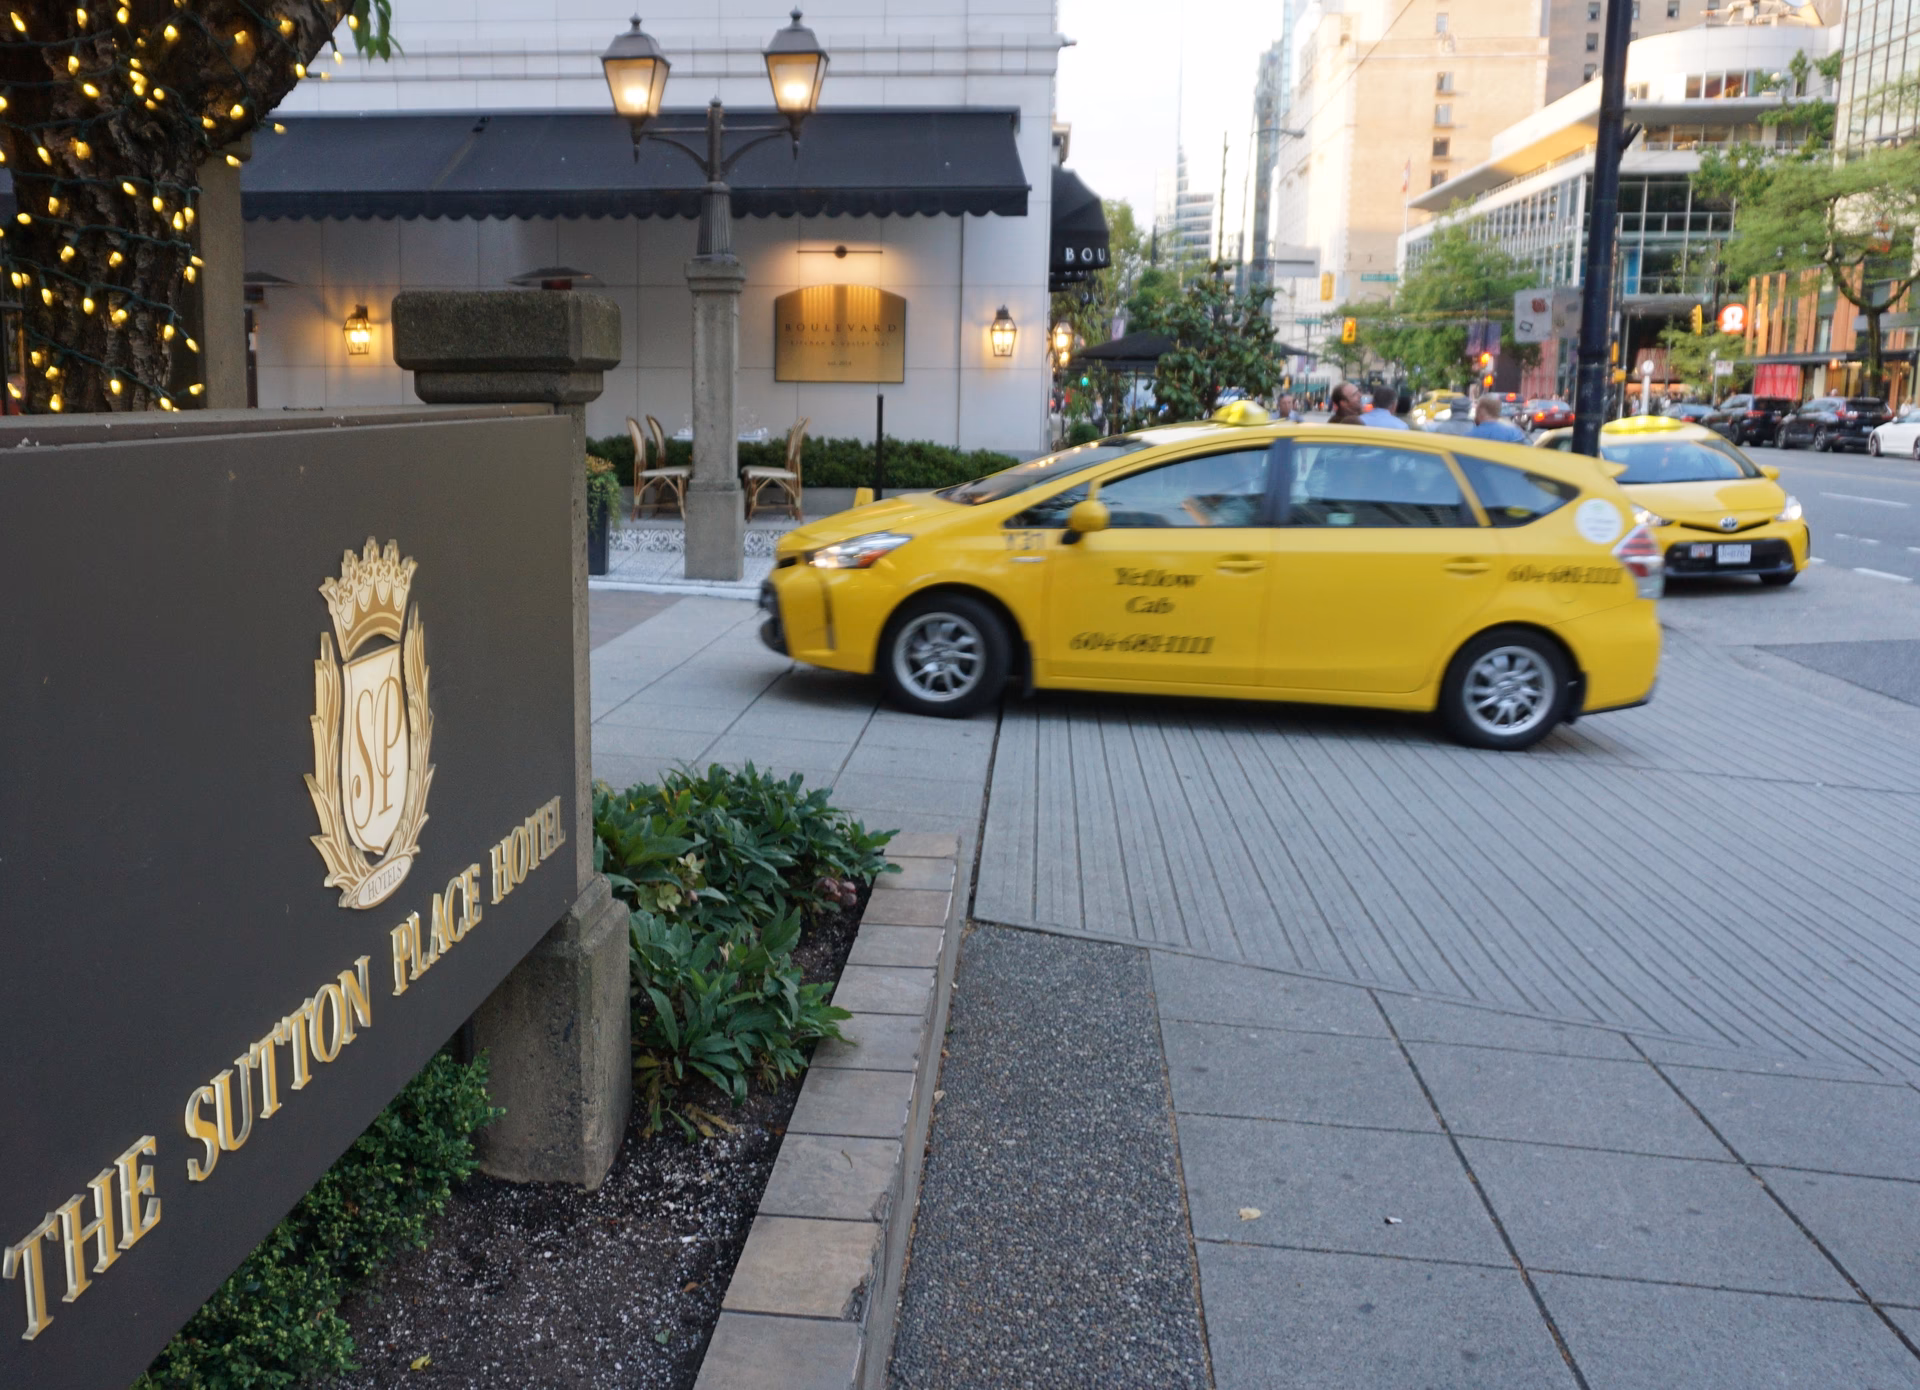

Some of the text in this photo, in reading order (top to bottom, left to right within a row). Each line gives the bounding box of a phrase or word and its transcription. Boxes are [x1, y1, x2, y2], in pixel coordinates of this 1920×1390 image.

[785, 323, 897, 333] BOULEVARD
[1115, 567, 1202, 588] Yellow
[1125, 596, 1176, 614] Cab
[367, 861, 402, 901] HOTELS
[3, 795, 566, 1341] THE SUTTON PLACE HOTEL
